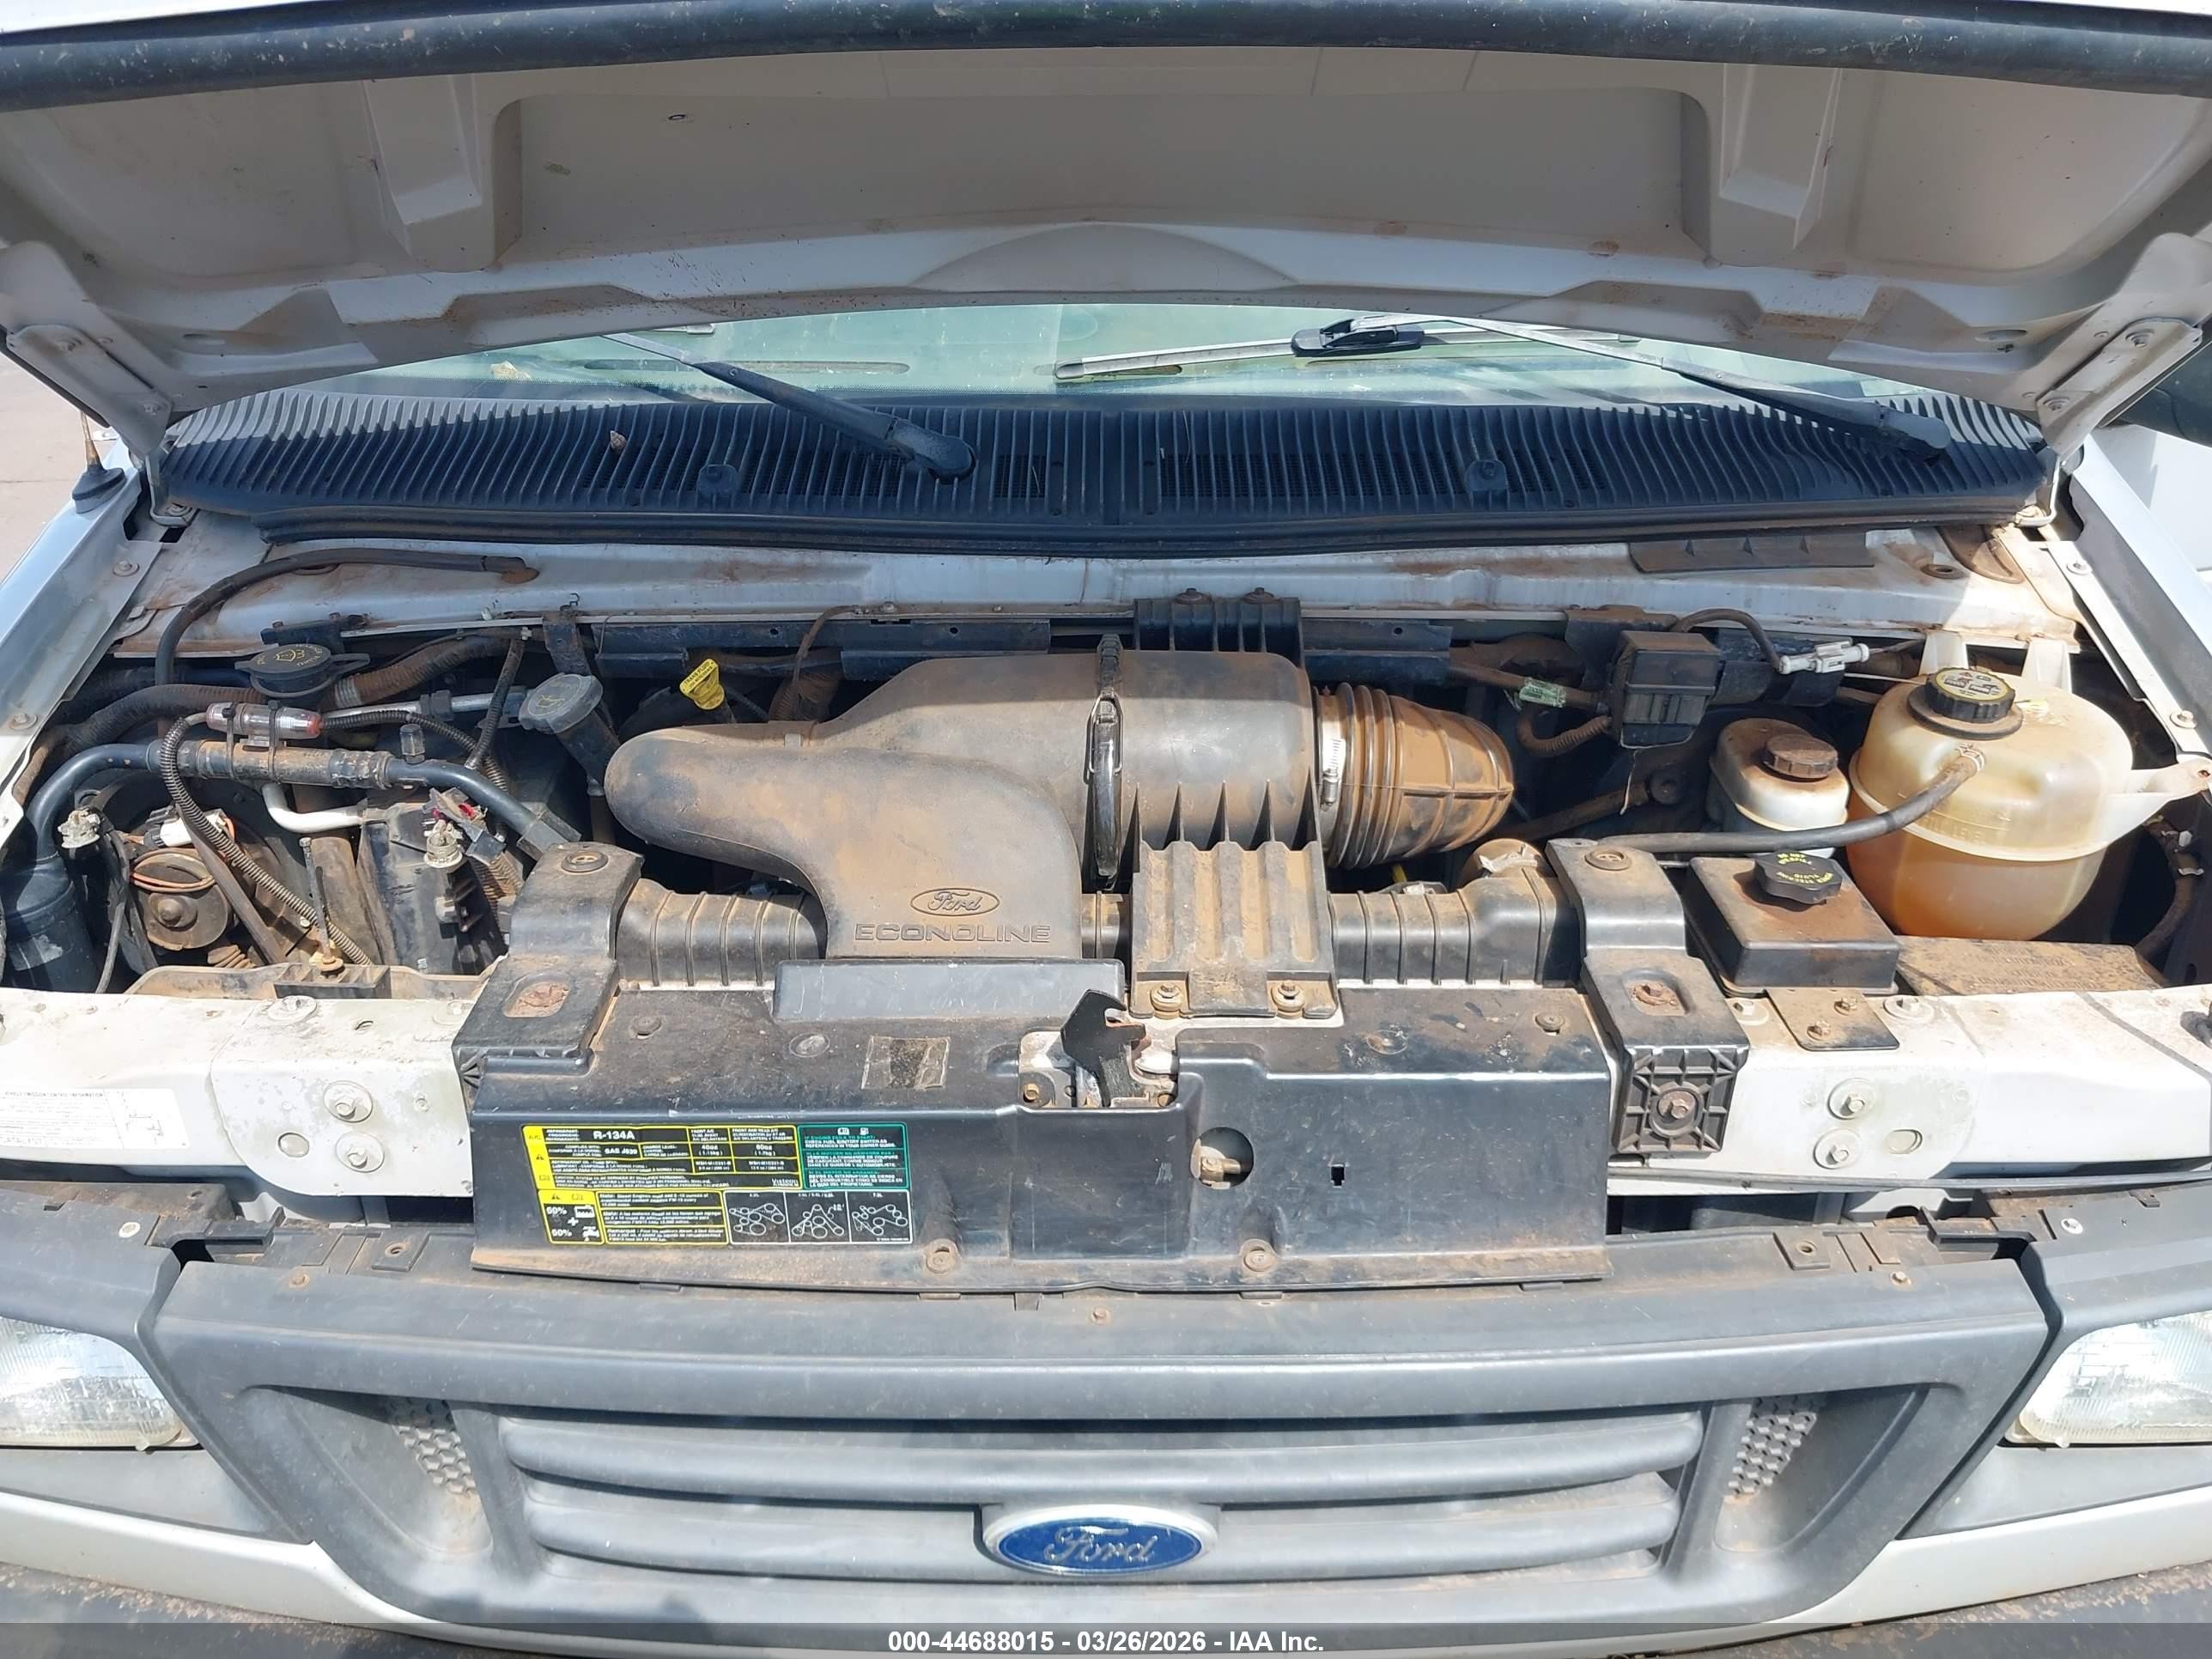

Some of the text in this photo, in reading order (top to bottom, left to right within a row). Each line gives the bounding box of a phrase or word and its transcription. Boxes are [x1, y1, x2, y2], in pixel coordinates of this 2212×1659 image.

[927, 890, 983, 912] Ford
[854, 922, 1051, 944] ECONOLINE
[592, 1131, 635, 1140] R-134A
[1044, 1525, 1157, 1565] Ford
